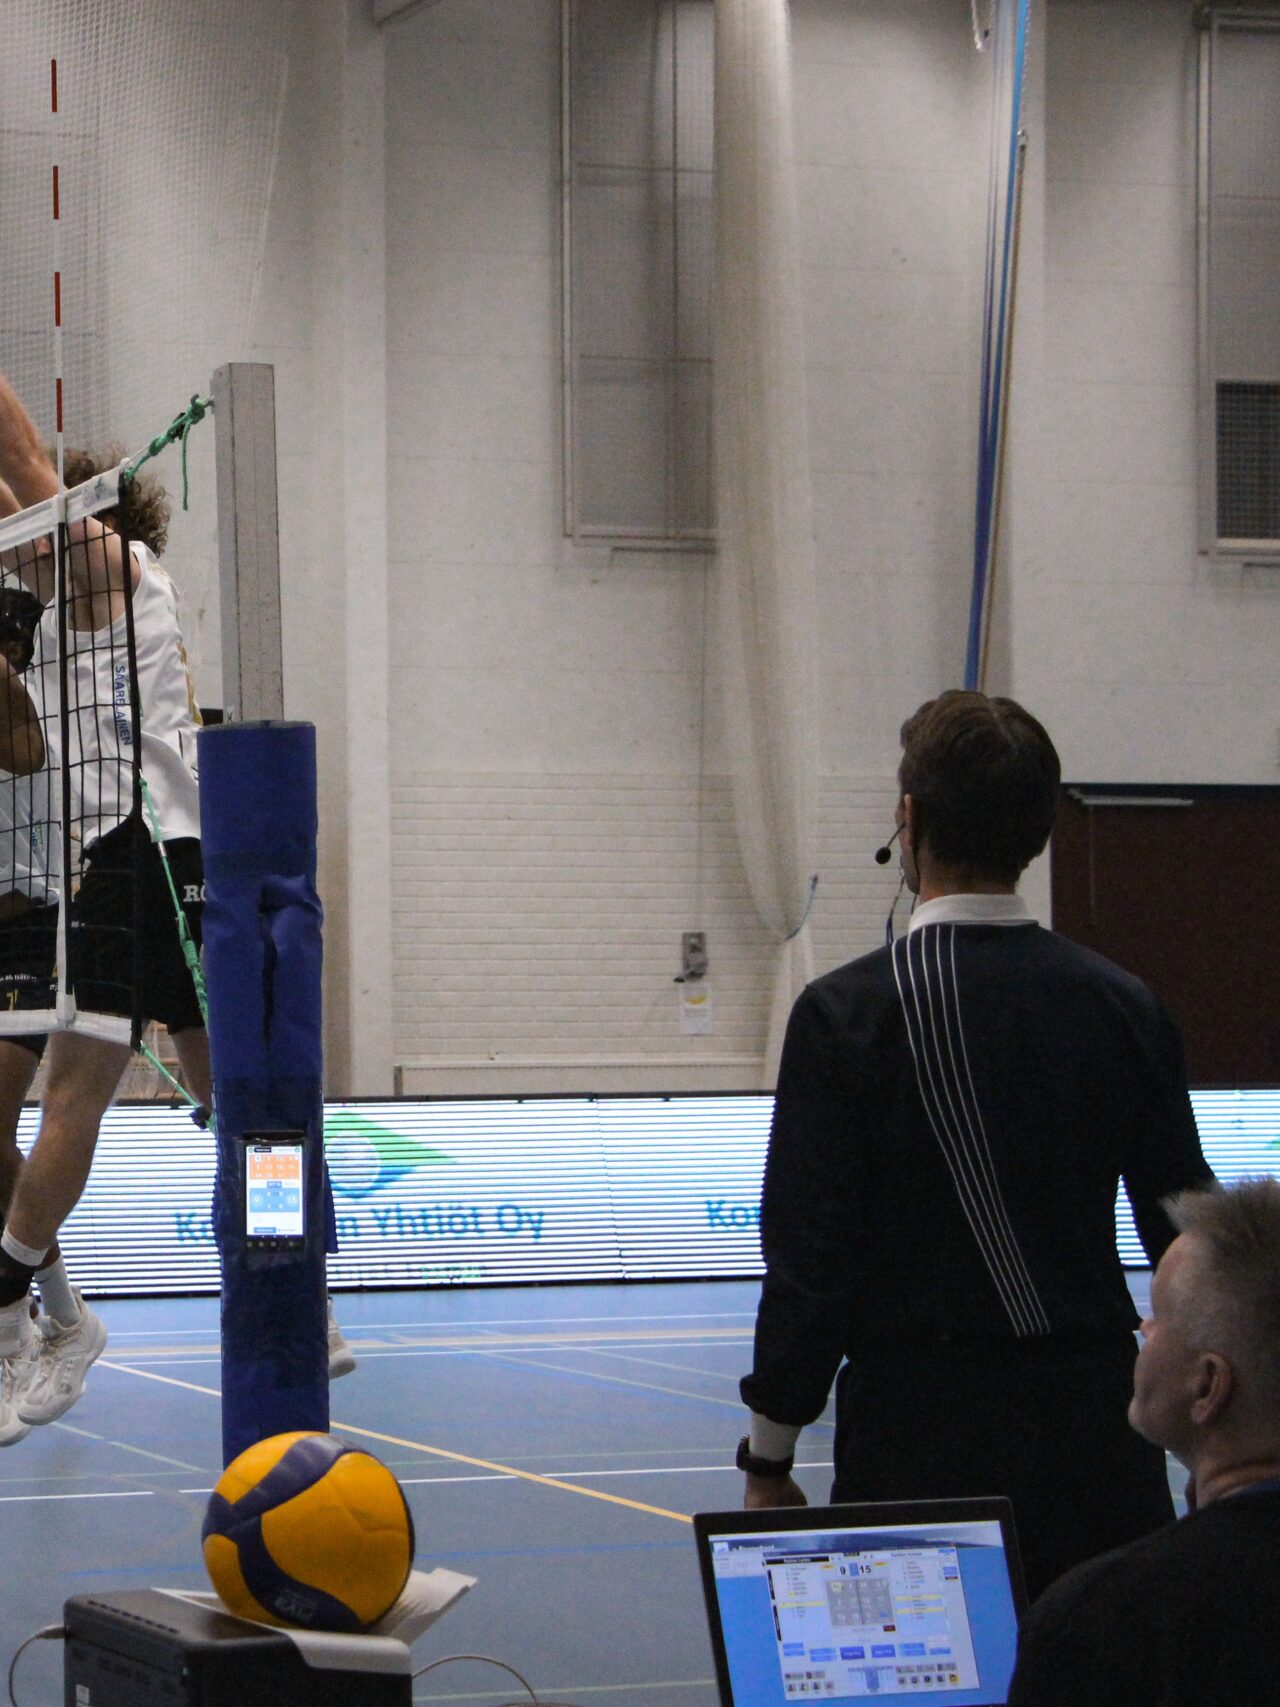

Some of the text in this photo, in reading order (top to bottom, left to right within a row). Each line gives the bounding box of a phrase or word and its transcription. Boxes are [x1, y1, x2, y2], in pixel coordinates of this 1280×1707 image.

[496, 1203, 545, 1242] Oy
[839, 1564, 872, 1576] 9 15
